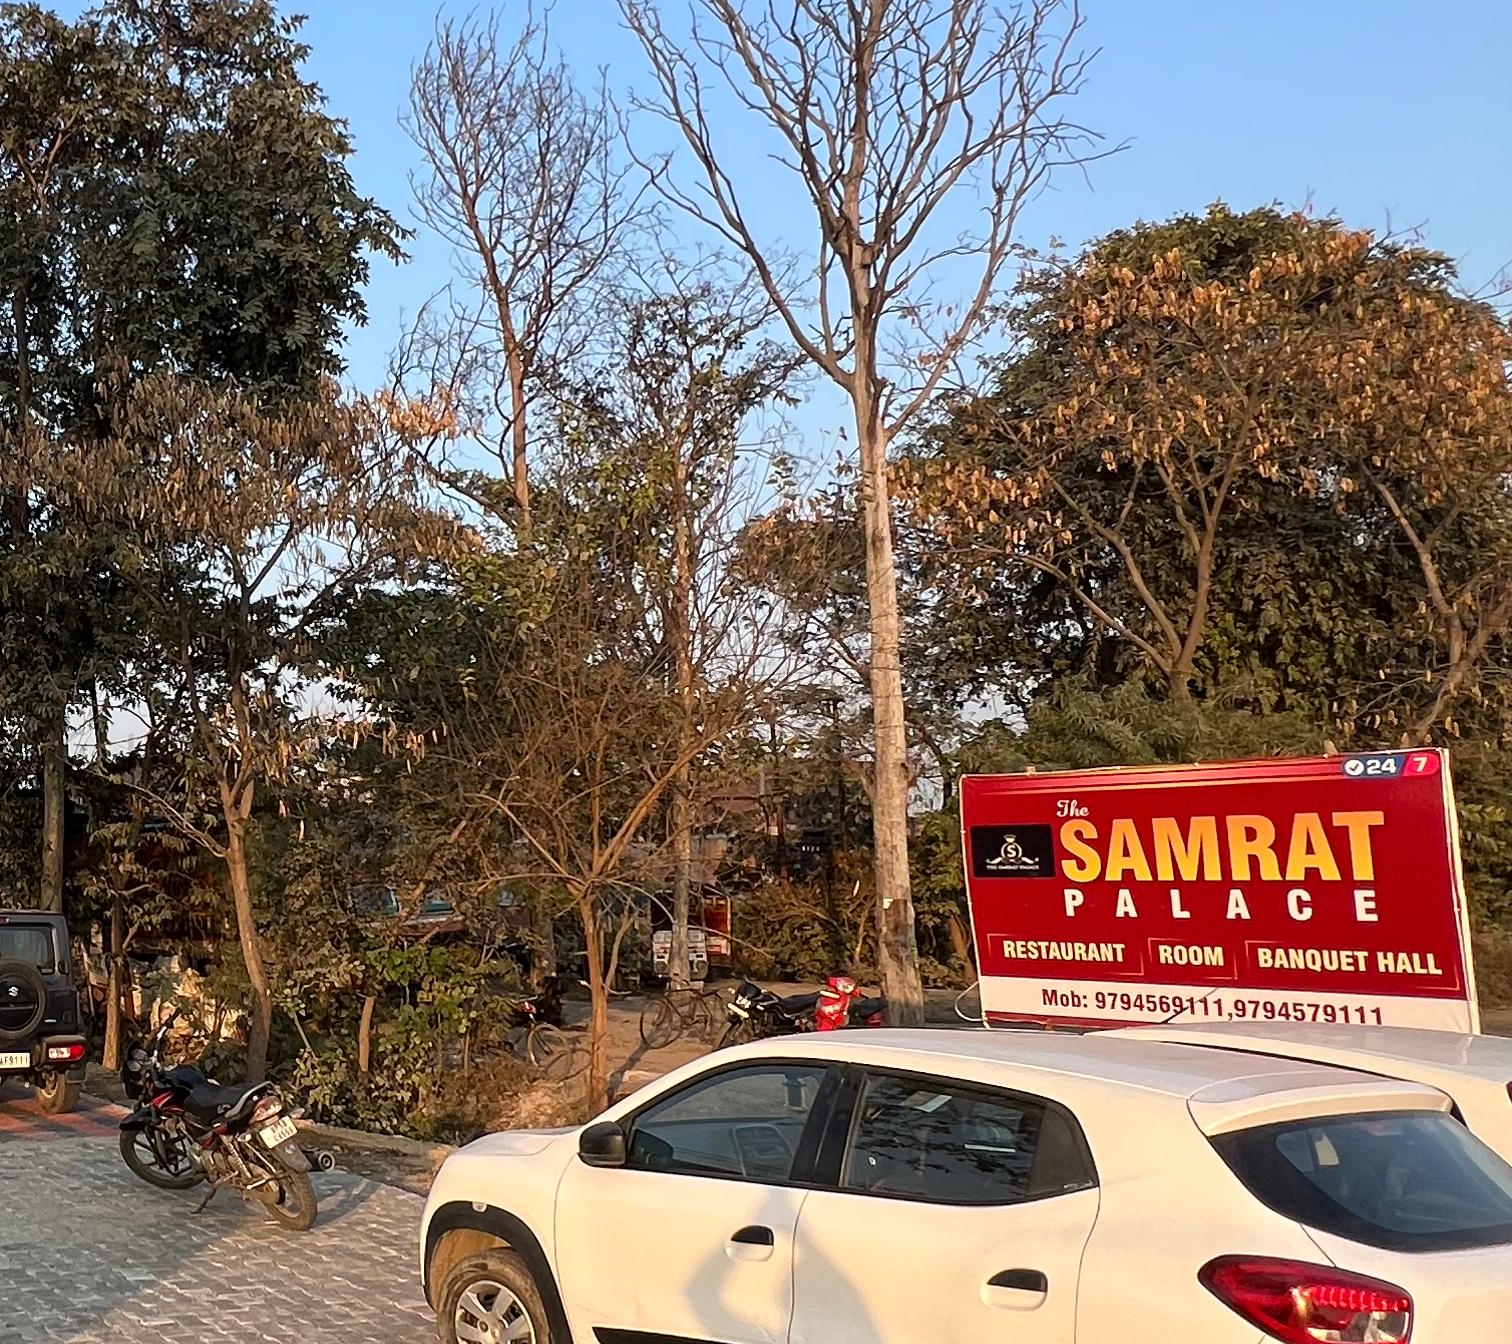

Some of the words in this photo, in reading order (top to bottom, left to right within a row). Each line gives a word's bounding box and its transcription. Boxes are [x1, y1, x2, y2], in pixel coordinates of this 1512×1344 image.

[1366, 758, 1397, 775] 24
[1412, 756, 1428, 773] 7
[1056, 799, 1090, 818] The
[1059, 810, 1384, 883] SAMRAT
[1063, 888, 1378, 922] PALACE
[1002, 940, 1125, 963] RESTAURANT
[1159, 944, 1224, 966] ROOM
[1257, 948, 1368, 972] BANQUET
[1377, 951, 1443, 975] HALL
[1042, 989, 1088, 1008] Mob:
